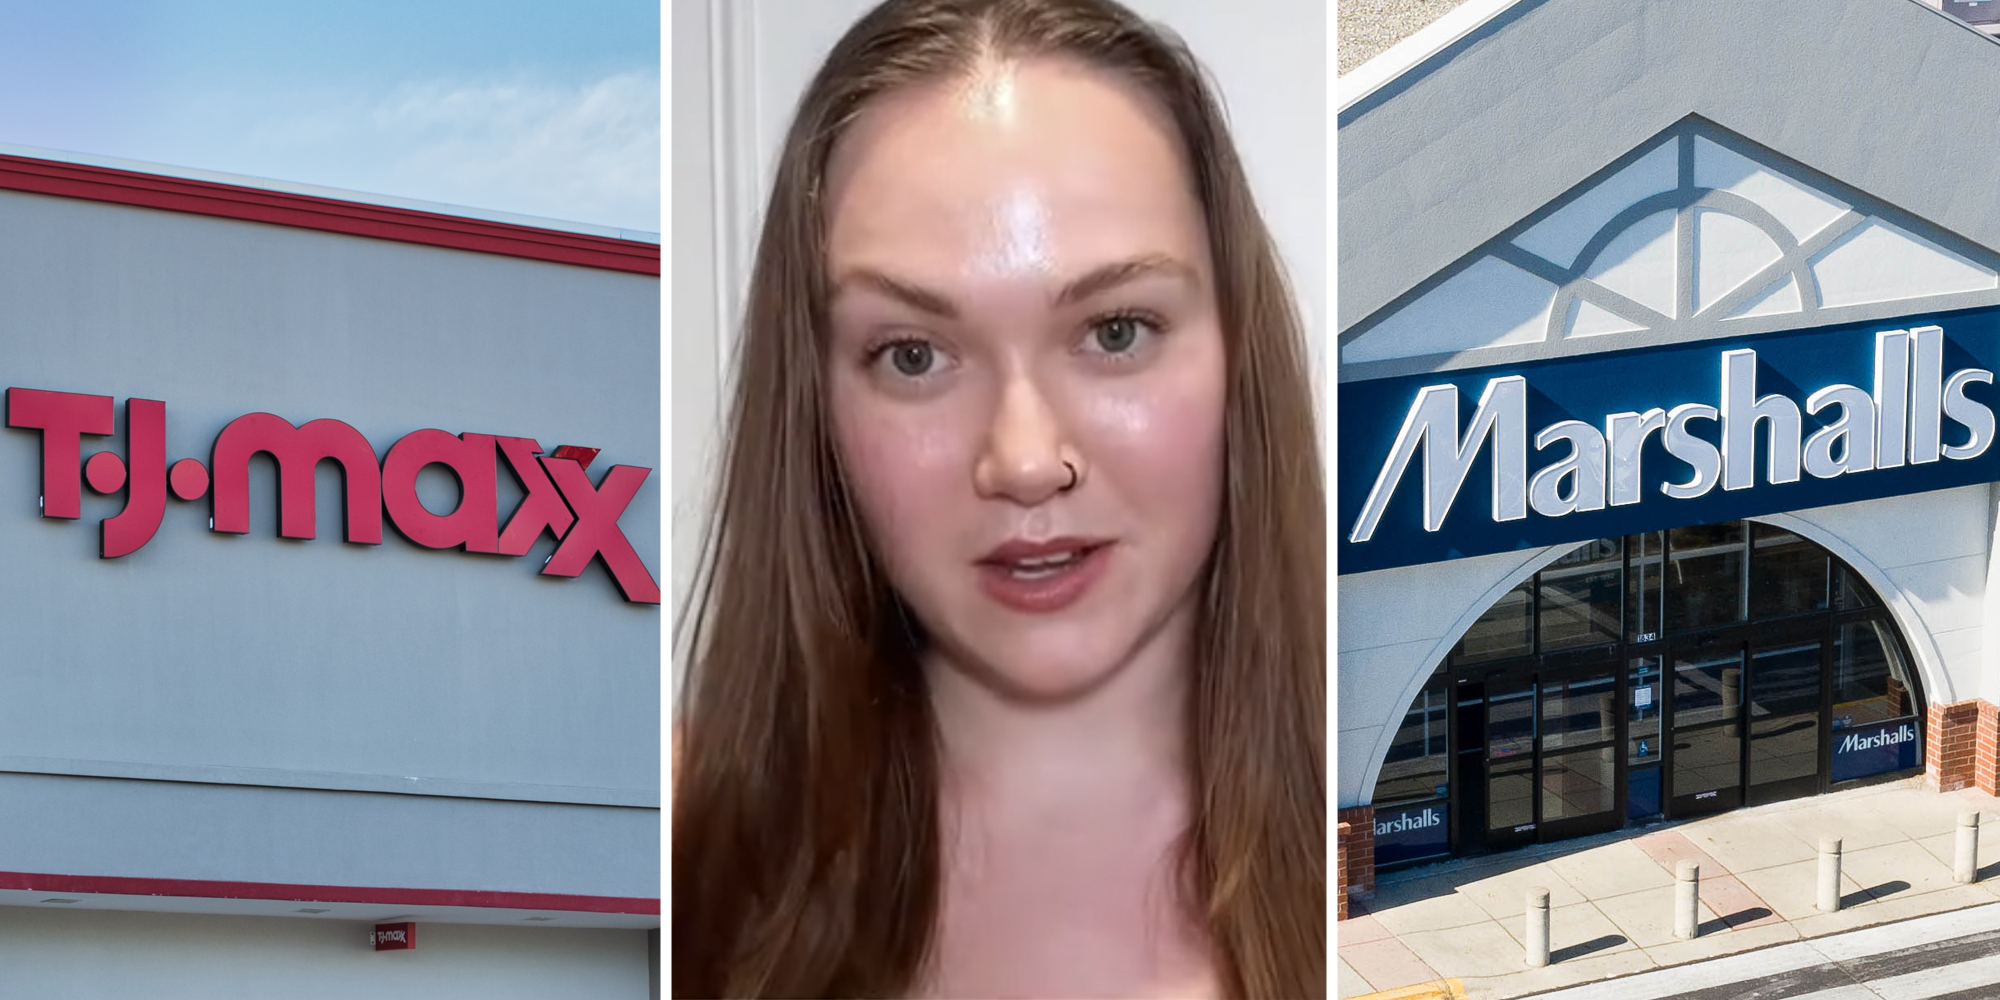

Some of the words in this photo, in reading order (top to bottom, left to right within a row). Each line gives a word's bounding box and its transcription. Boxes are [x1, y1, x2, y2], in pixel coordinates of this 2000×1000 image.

[1349, 325, 1996, 543] Marshalls
[1838, 724, 1914, 754] Marshalls
[1373, 808, 1440, 835] arshalls
